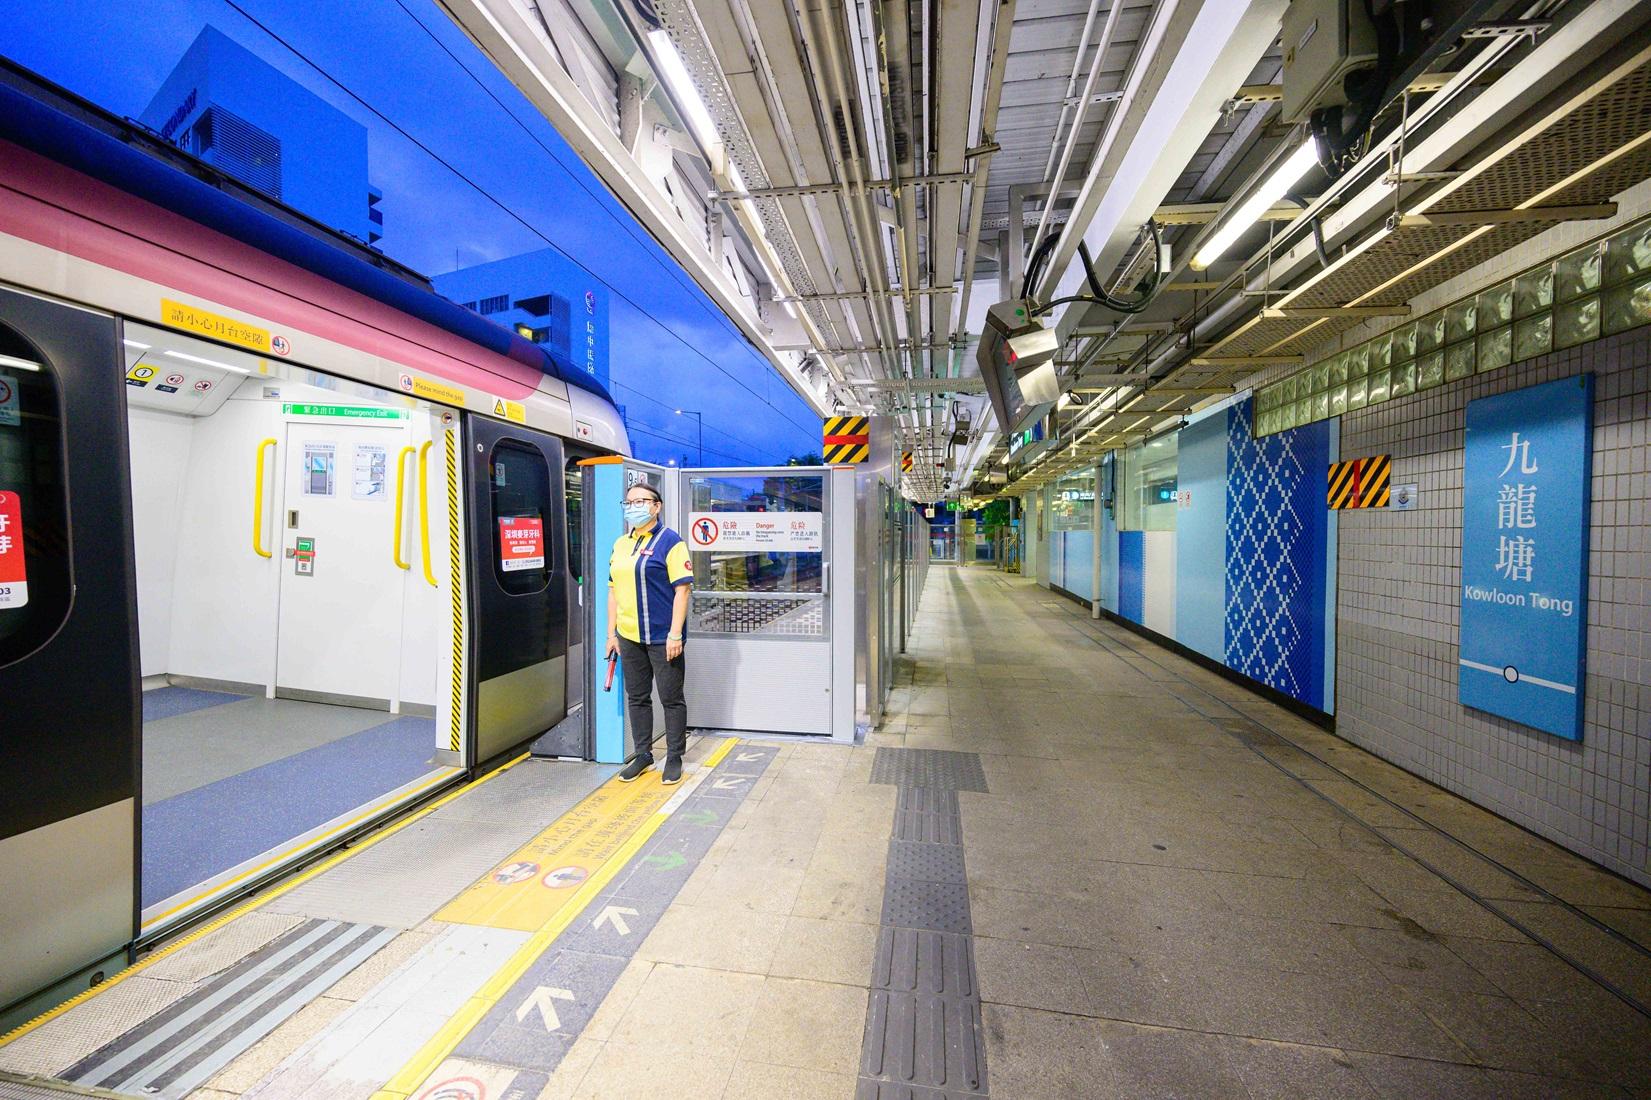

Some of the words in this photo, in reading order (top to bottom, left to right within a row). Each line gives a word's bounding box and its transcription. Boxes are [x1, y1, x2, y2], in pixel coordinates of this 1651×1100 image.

[171, 309, 265, 345] 請小心月台空隙
[415, 382, 432, 392] Please
[433, 387, 445, 396] mind
[303, 406, 336, 415] 緊急出口
[344, 408, 374, 417] Emergency
[376, 409, 388, 417] Exit
[1495, 432, 1539, 582] 九龍塘
[723, 521, 737, 530] 危險
[756, 522, 775, 530] Danger
[1465, 585, 1526, 607] Kowloon
[1529, 592, 1573, 617] Tong
